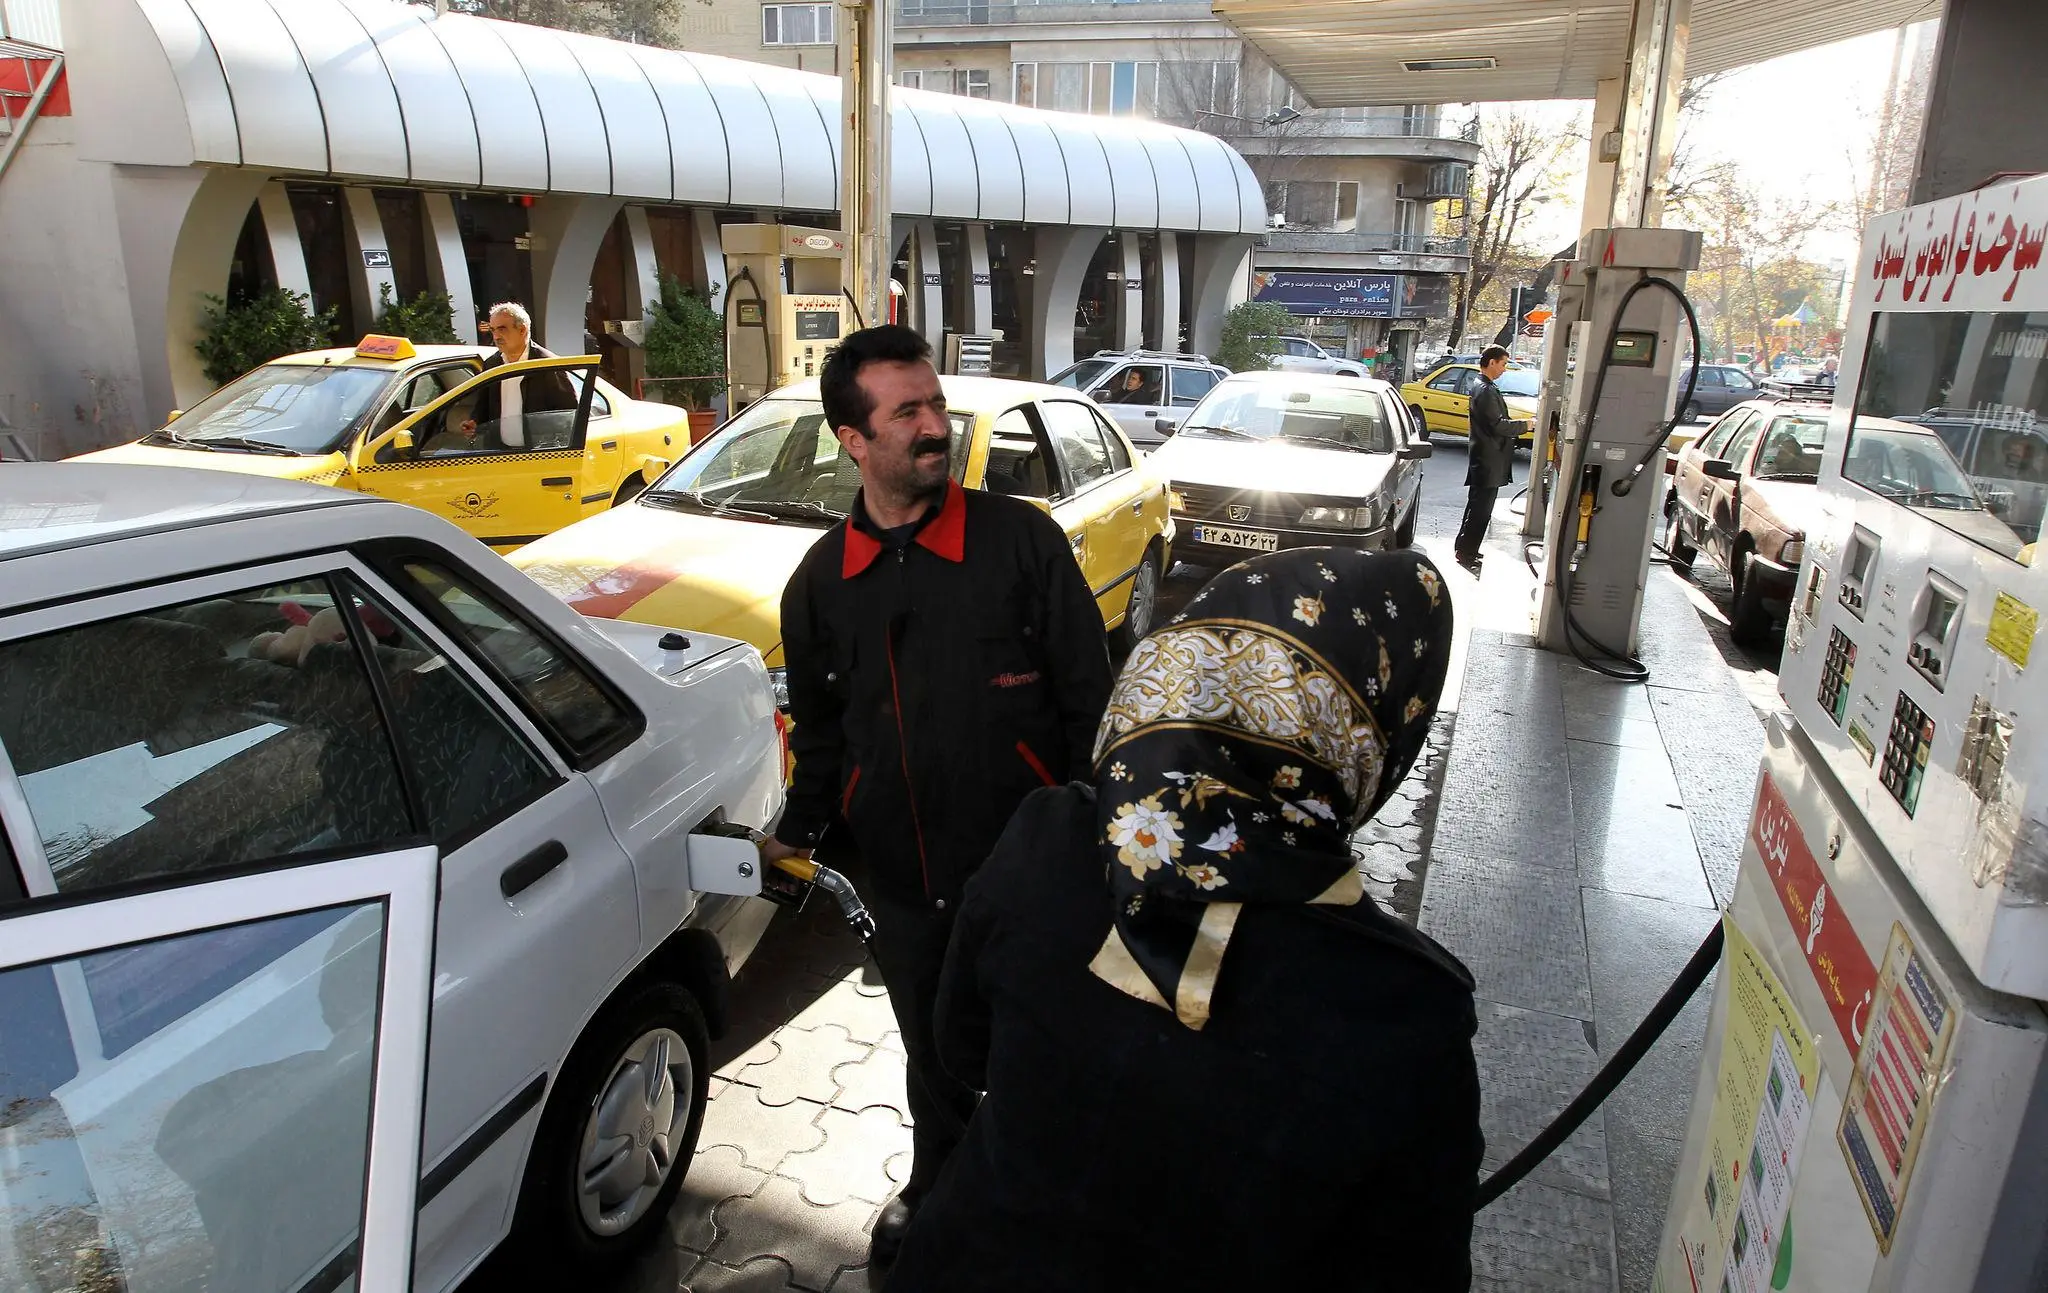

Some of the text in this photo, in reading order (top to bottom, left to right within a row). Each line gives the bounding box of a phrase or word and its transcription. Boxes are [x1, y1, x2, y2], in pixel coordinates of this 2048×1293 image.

[1333, 278, 1363, 291] آنلاین
[1364, 280, 1391, 292] پارس
[1991, 331, 2048, 359] AMOUN
